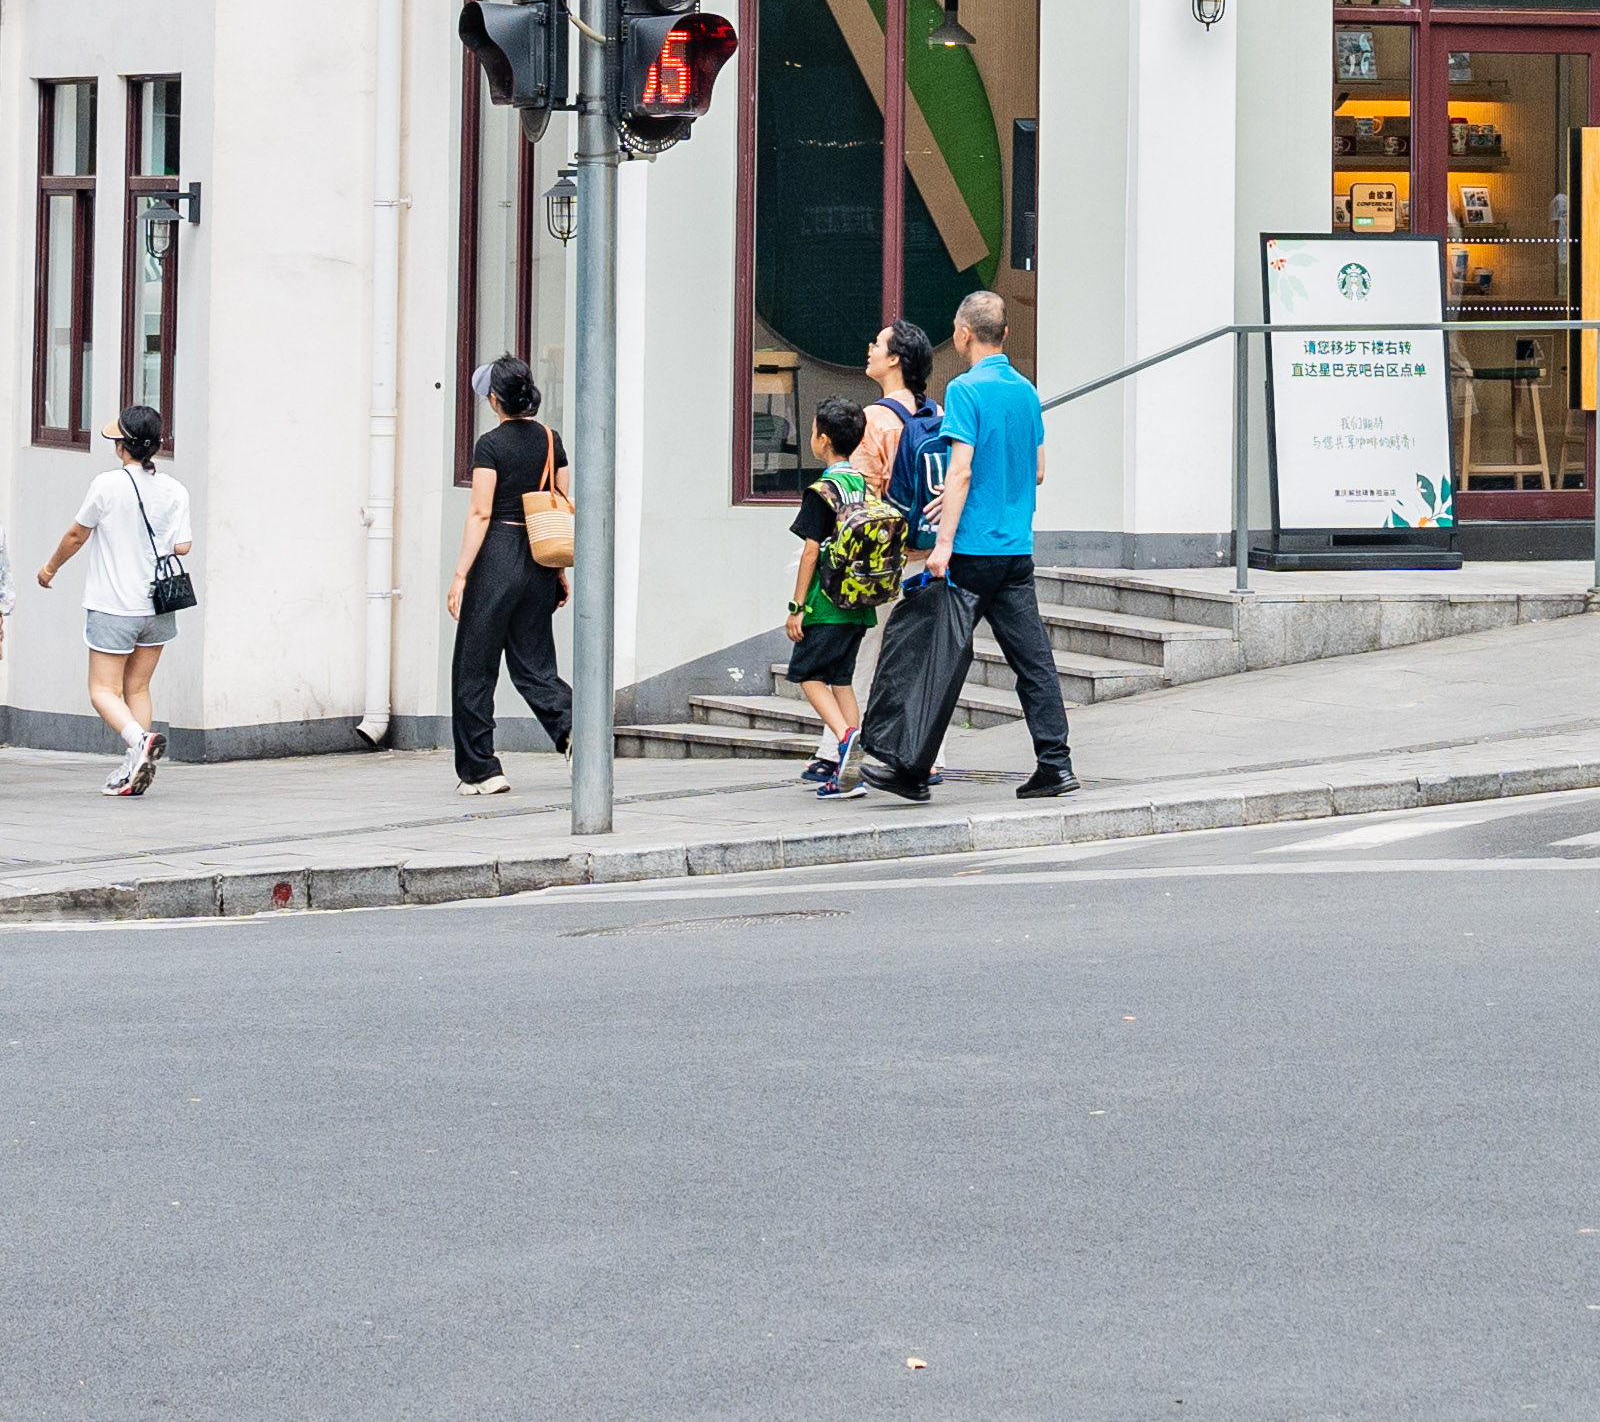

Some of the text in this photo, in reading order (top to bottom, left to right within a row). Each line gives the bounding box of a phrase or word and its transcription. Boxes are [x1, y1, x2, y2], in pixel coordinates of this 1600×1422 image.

[1304, 340, 1412, 356] 请您移步下楼右转
[1291, 362, 1427, 378] 直达星巴克吧台区点单
